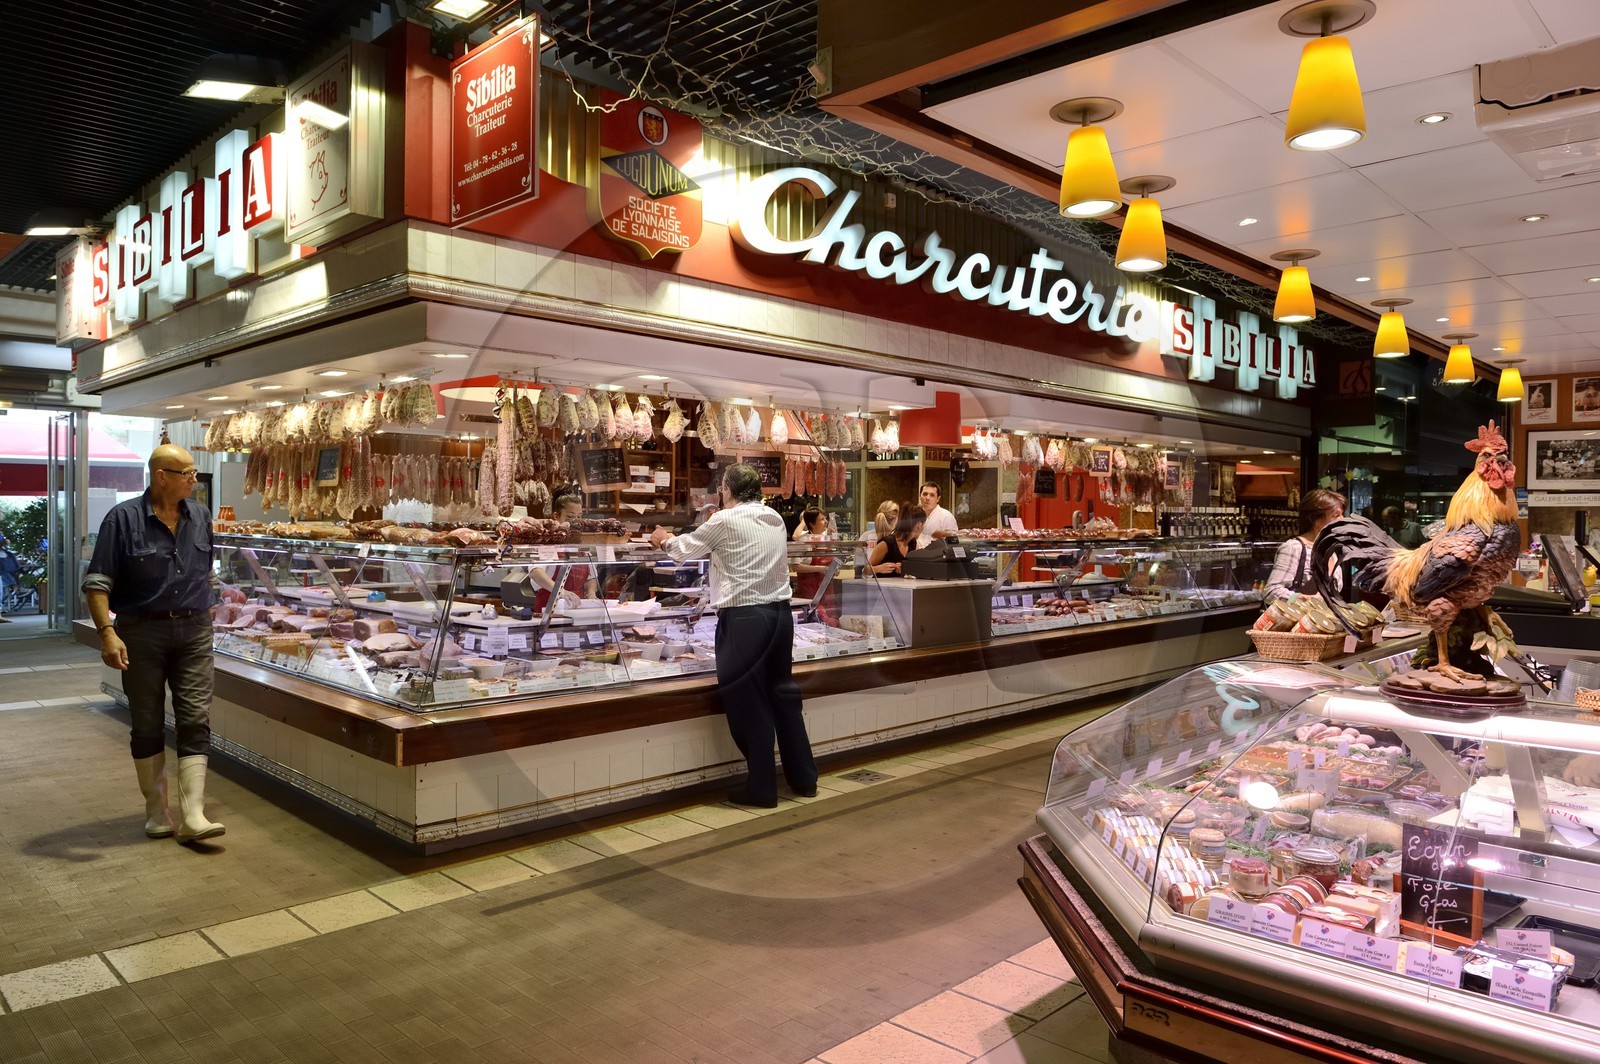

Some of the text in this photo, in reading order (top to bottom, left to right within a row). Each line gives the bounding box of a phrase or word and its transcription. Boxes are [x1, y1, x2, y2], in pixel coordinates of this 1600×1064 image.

[466, 64, 516, 114] Sibilia
[467, 96, 513, 128] Charcuterie
[474, 114, 506, 138] Traiteur
[616, 152, 688, 196] LUGDUNUM
[94, 144, 271, 304] SIBILIA
[612, 218, 690, 248] DE SALAISONS
[622, 207, 682, 234] LYONNAISE
[734, 167, 1316, 384] Charcuterie SIBILIA
[1408, 836, 1472, 860] Ecrin
[1419, 894, 1458, 913] Gras
